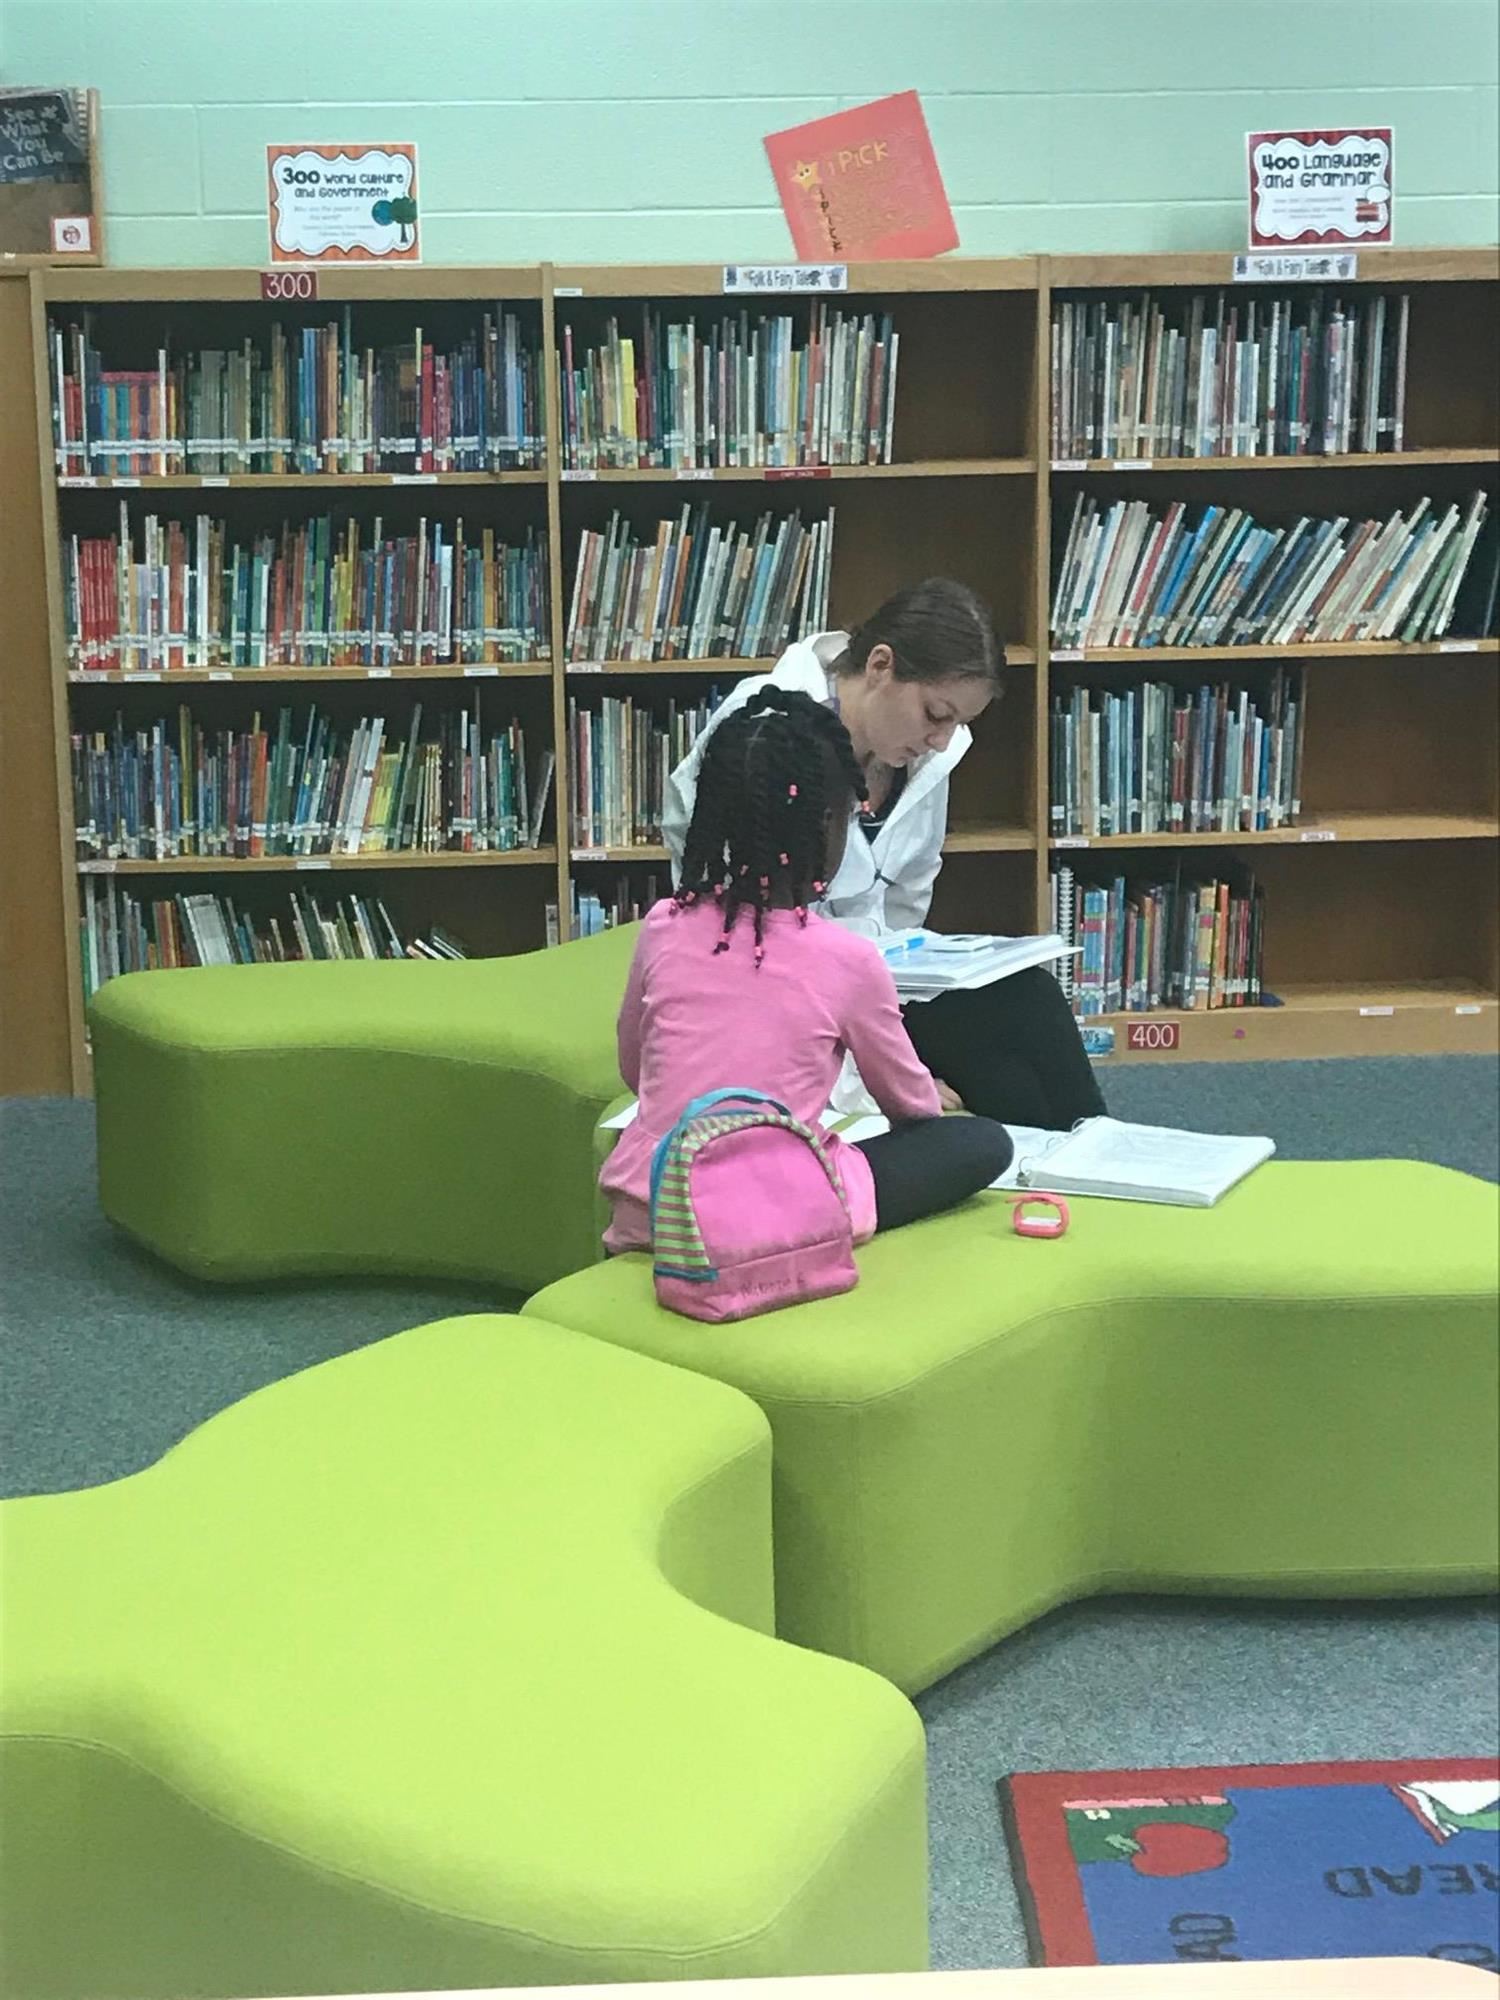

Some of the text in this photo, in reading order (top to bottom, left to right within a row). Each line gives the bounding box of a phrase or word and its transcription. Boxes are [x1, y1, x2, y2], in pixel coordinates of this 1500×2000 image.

[0, 120, 48, 138] What
[11, 137, 47, 152] You
[4, 154, 39, 170] Can
[1262, 152, 1381, 170] 400 Language
[283, 167, 320, 185] 300
[1264, 171, 1376, 189] and Grammar
[294, 186, 389, 199] and Government
[266, 272, 312, 299] 300
[1132, 1025, 1174, 1048] 400
